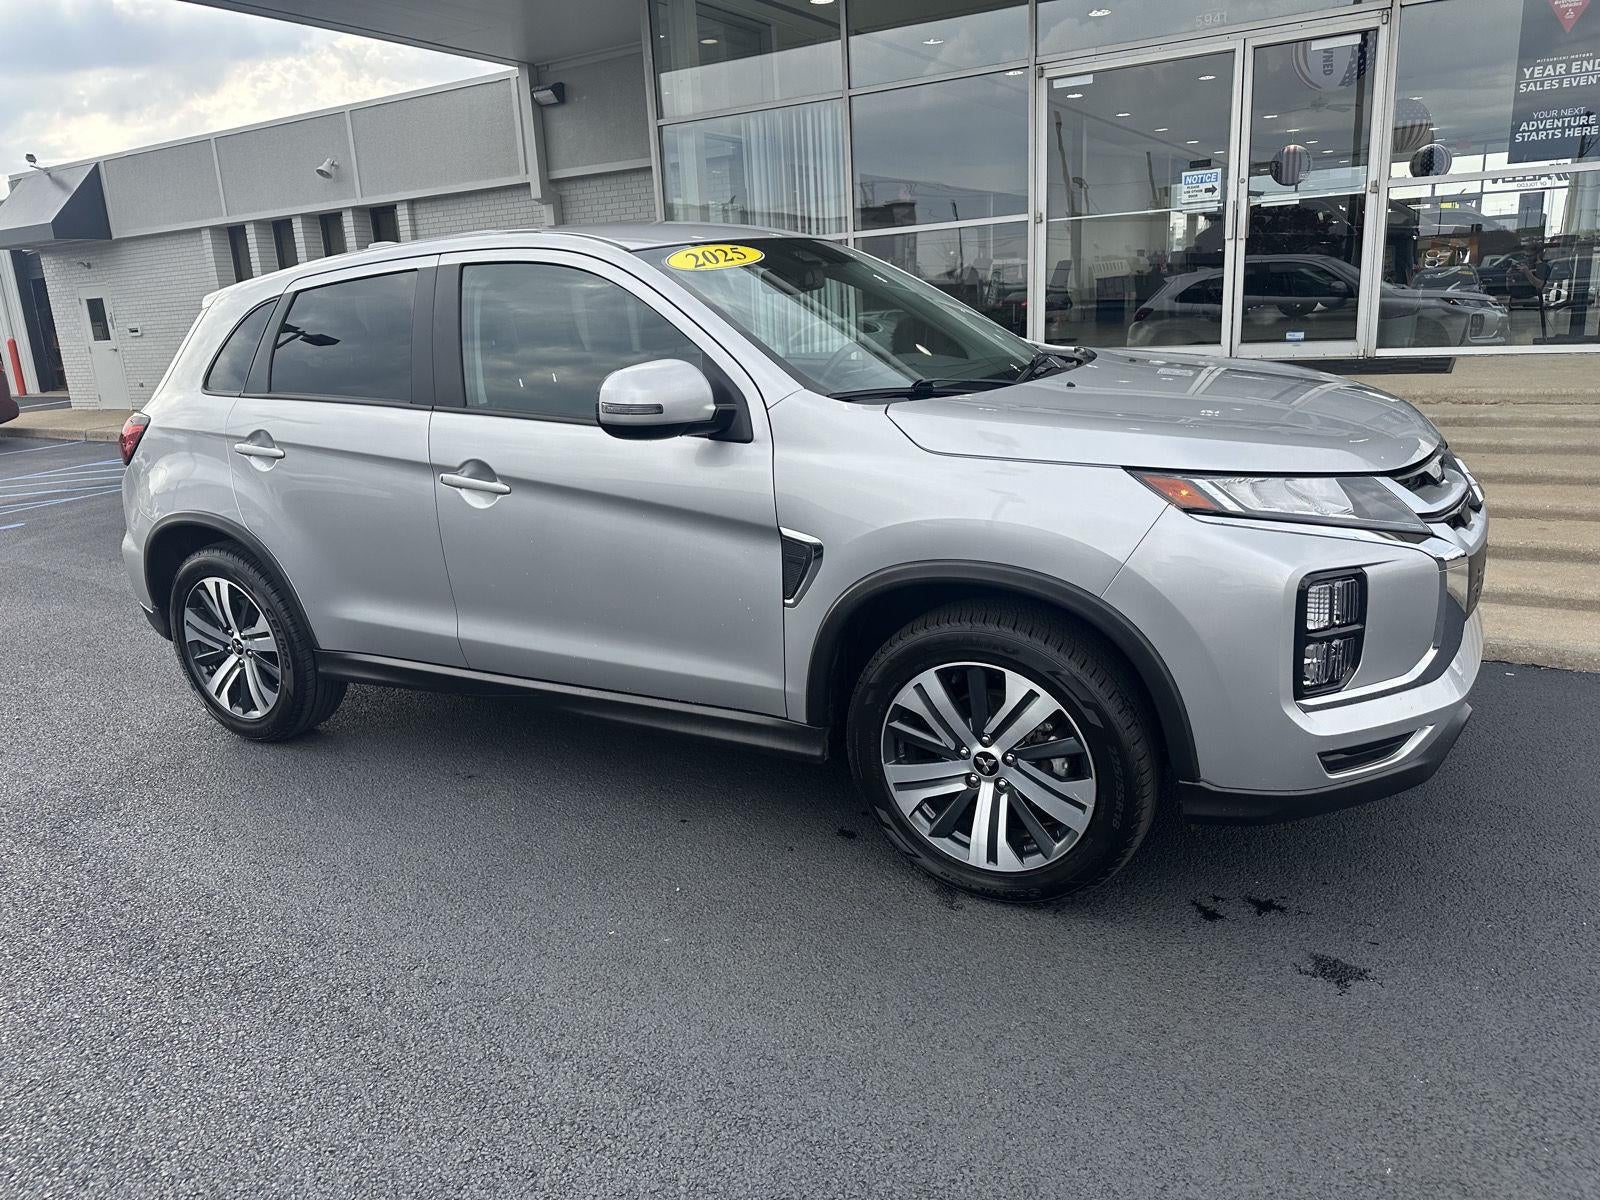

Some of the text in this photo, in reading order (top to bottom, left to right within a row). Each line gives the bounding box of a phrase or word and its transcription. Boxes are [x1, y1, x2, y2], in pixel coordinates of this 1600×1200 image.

[1322, 50, 1334, 76] WNED
[1570, 52, 1593, 60] MOTORS
[1523, 63, 1566, 79] YEAR
[1520, 80, 1559, 93] SALES
[1533, 107, 1586, 119] YOUR NEXT
[1519, 115, 1597, 132] ADVENTURE
[1515, 125, 1599, 142] STARTS HERE
[1186, 173, 1217, 184] NOTICE
[685, 247, 747, 268] 2025
